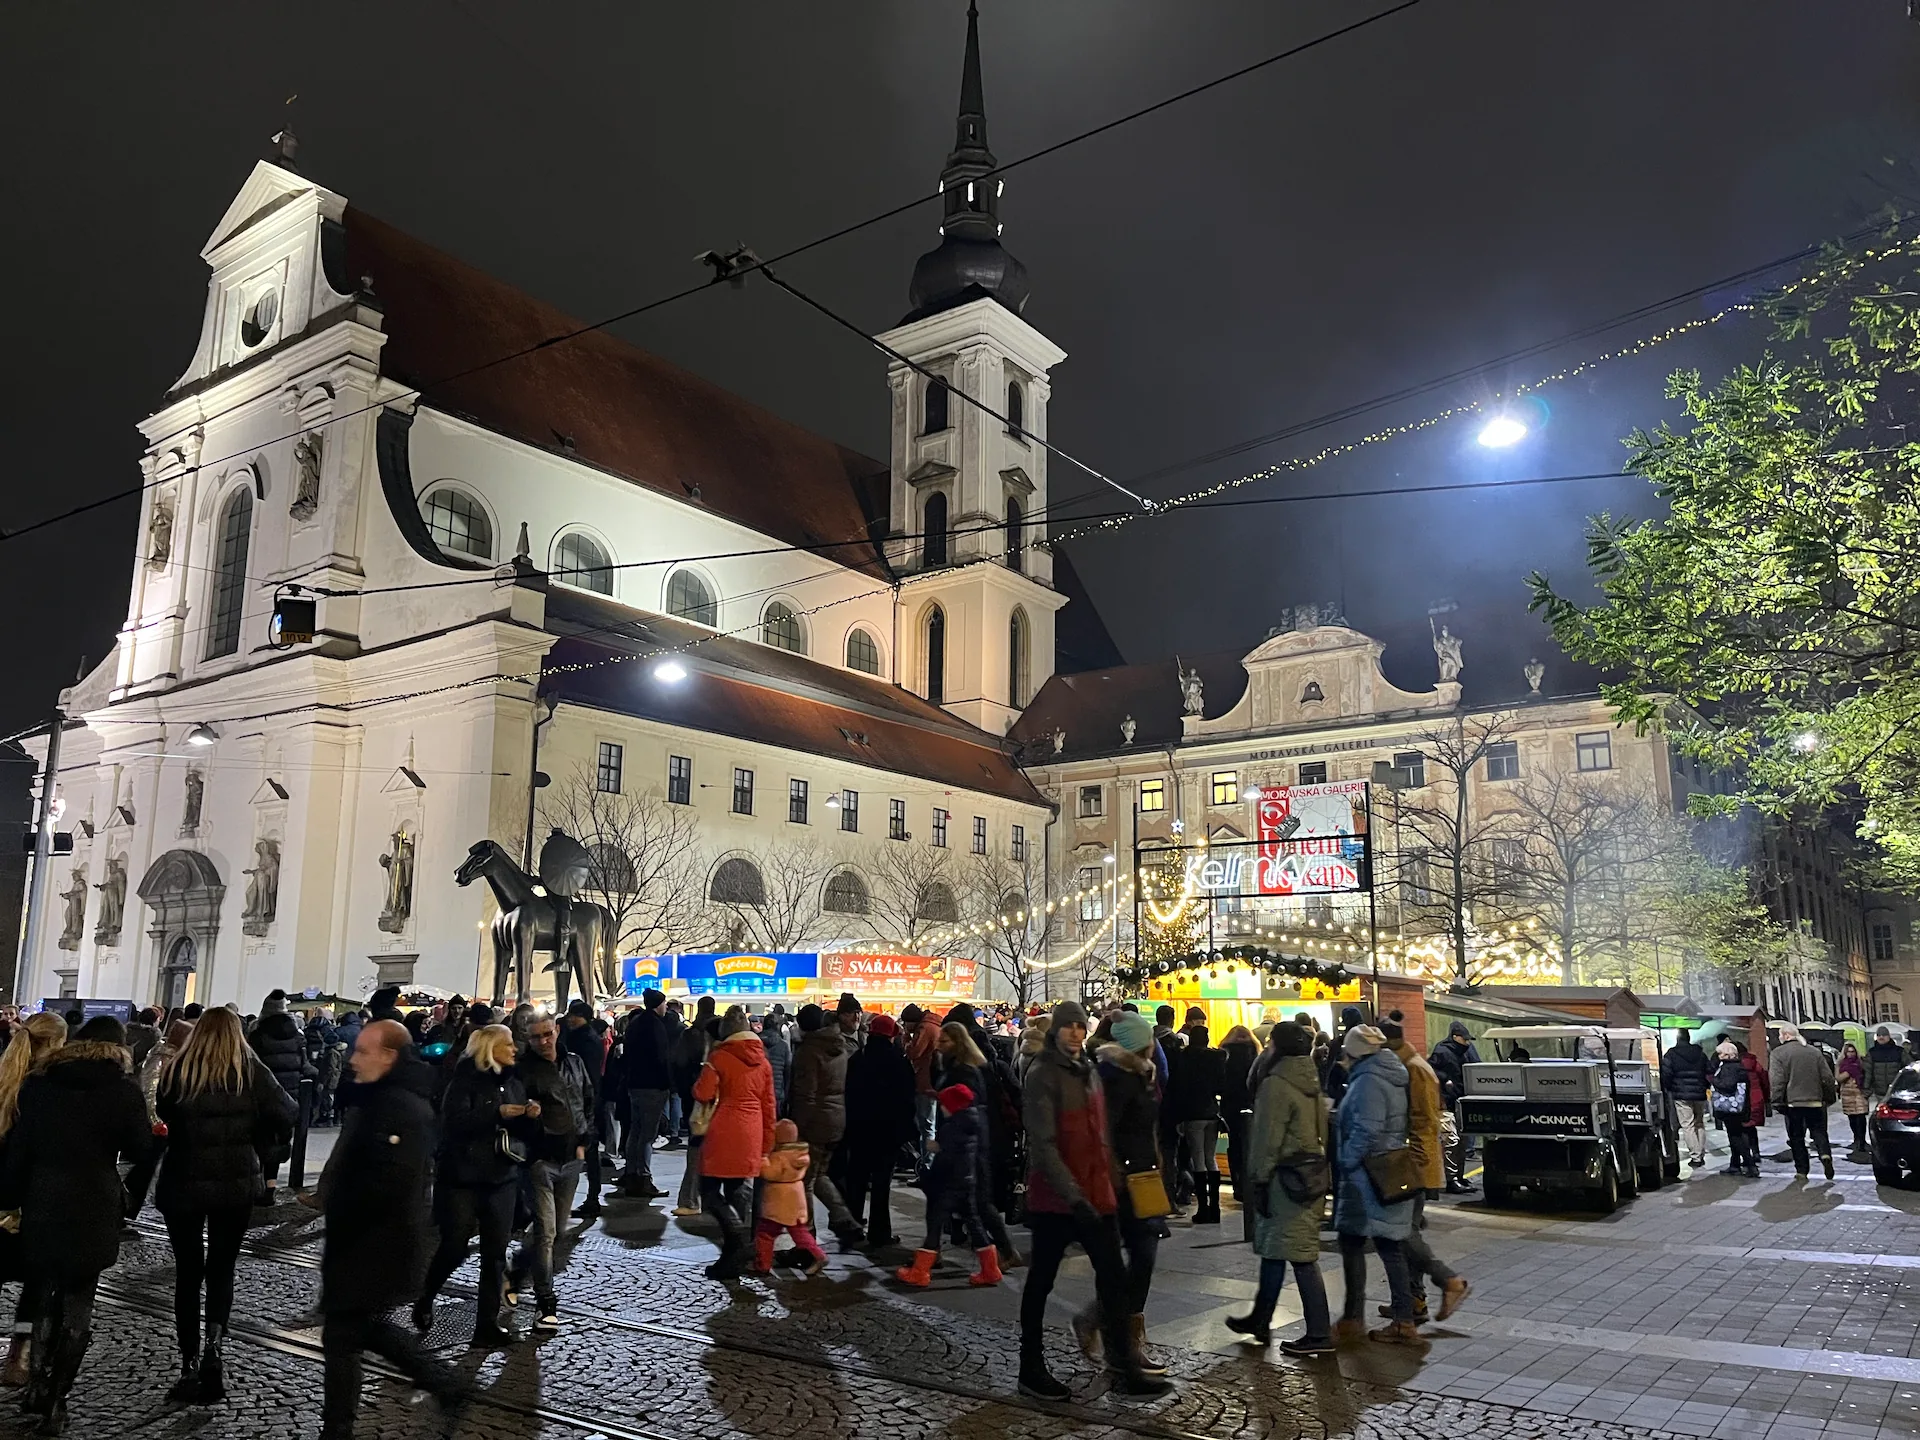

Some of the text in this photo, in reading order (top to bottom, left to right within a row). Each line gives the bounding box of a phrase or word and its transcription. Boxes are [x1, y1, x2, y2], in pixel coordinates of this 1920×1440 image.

[1249, 739, 1377, 760] MORAVSKÁ GALERIE
[1260, 782, 1366, 800] MORAVSKÁ GALERIE
[848, 958, 904, 974] SVAŘÁK
[1468, 1113, 1484, 1123] ECO
